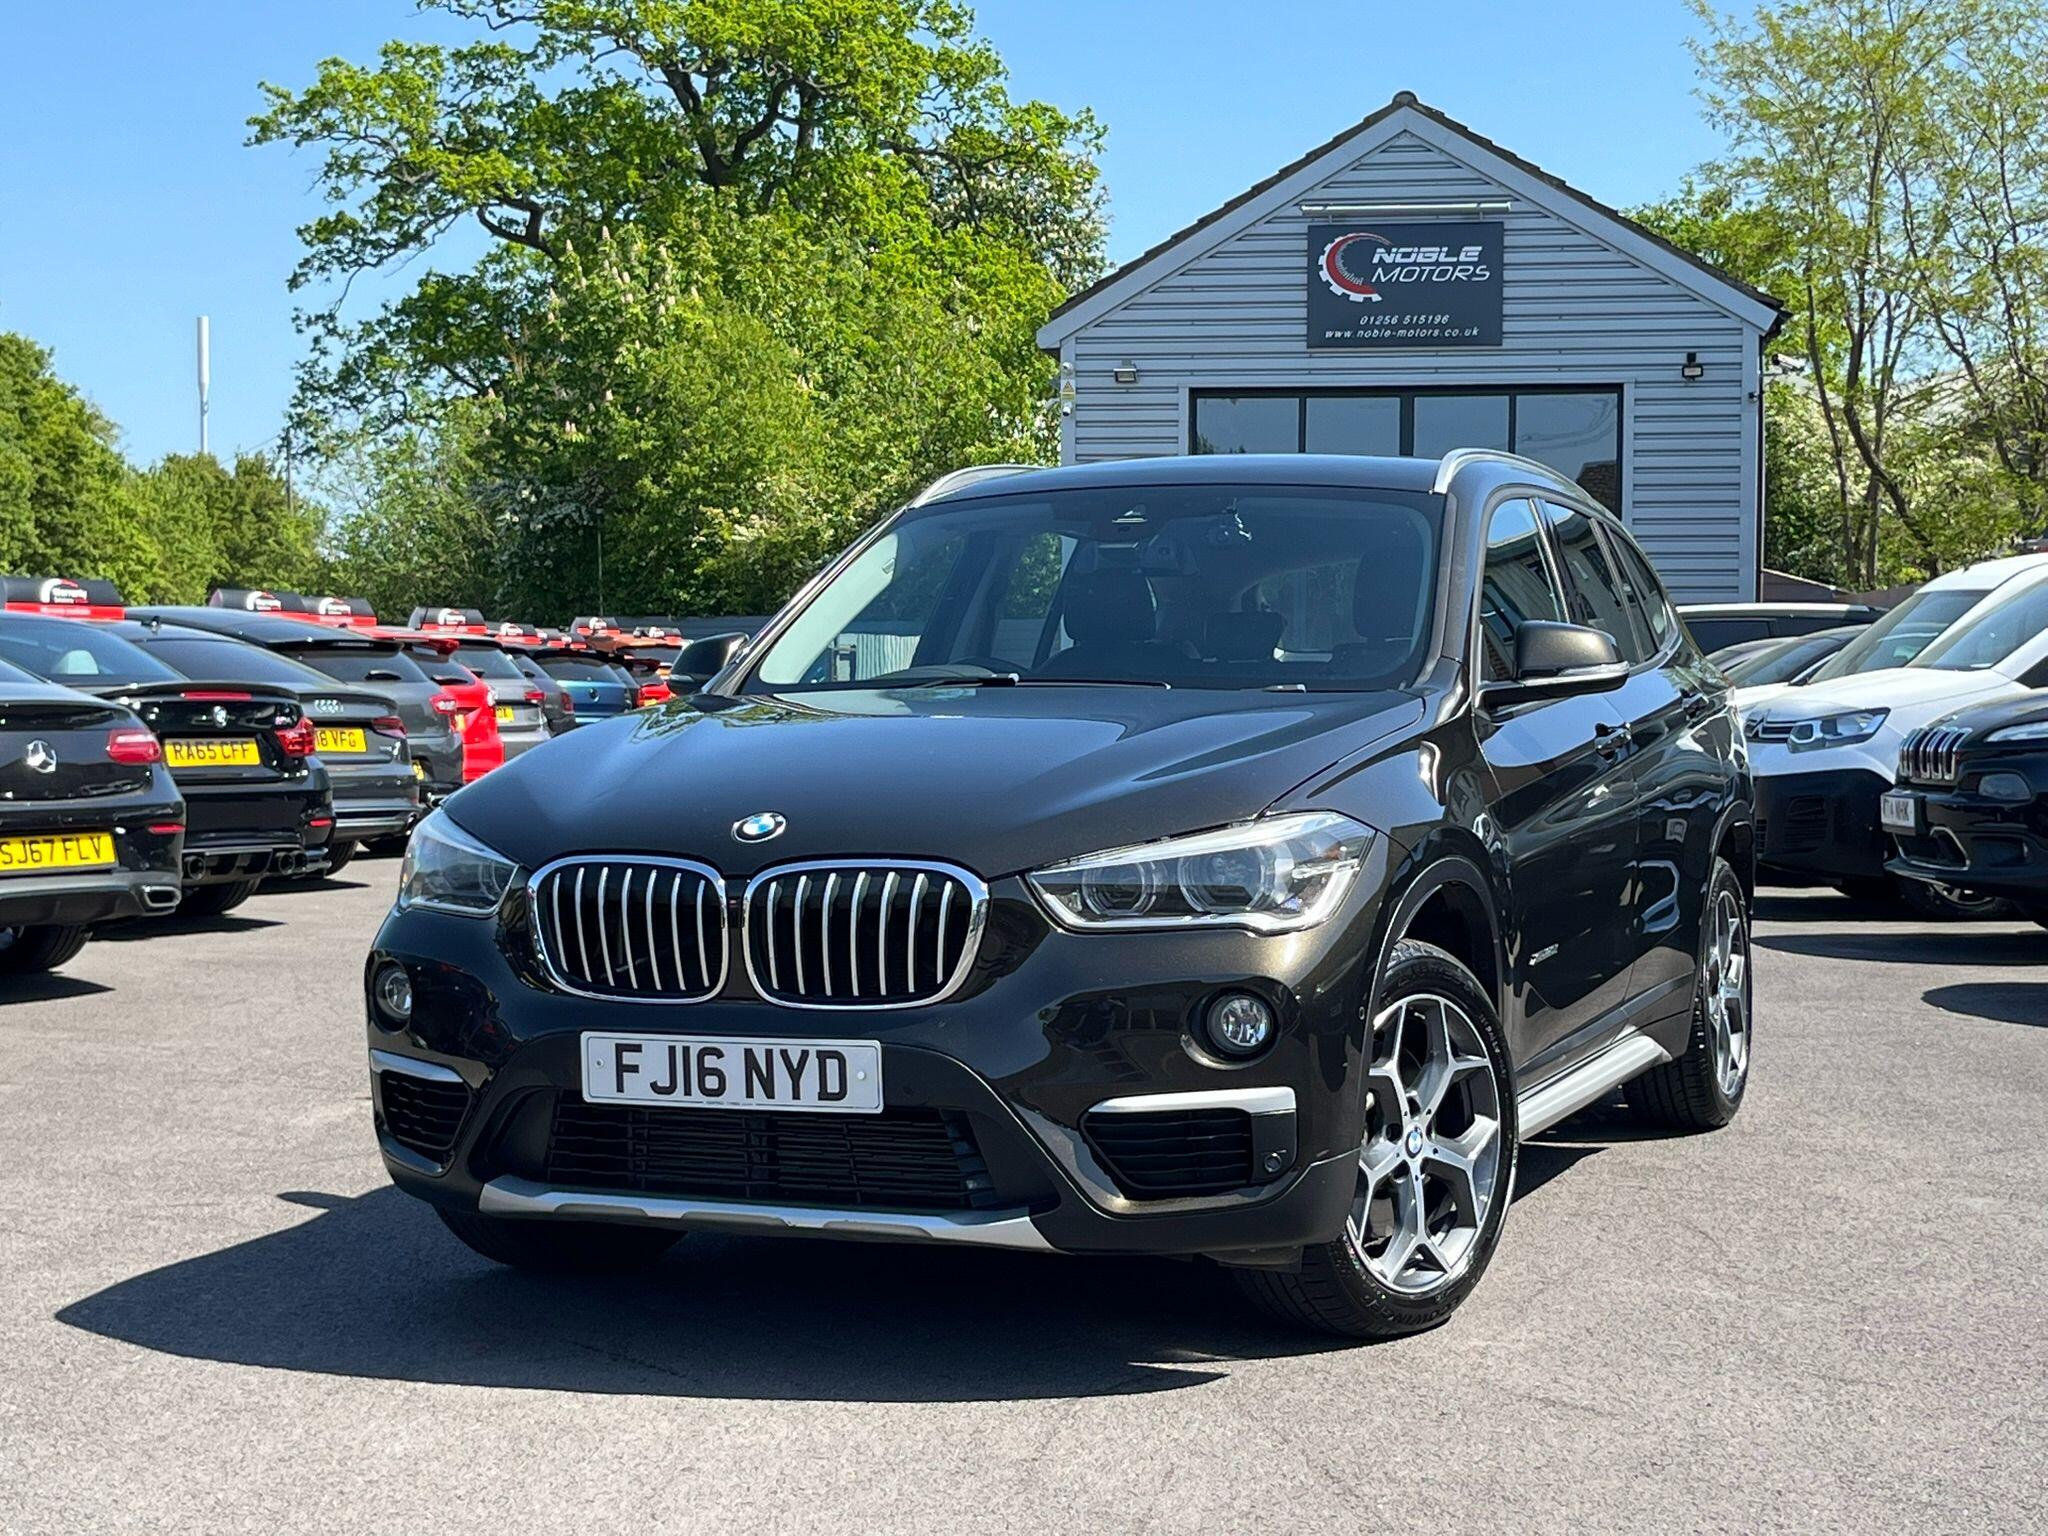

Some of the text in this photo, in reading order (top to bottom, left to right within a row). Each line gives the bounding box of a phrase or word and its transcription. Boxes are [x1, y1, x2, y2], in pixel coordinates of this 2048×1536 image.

[1372, 246, 1483, 264] NOBLE
[1372, 265, 1491, 283] MOTORS
[1359, 314, 1450, 326] 01256 515196
[1325, 327, 1480, 339] www.noble-motors.co.uk
[172, 741, 217, 760] RA65
[0, 835, 101, 865] SJ67 FLV
[614, 1043, 849, 1102] FJ16 NYD
